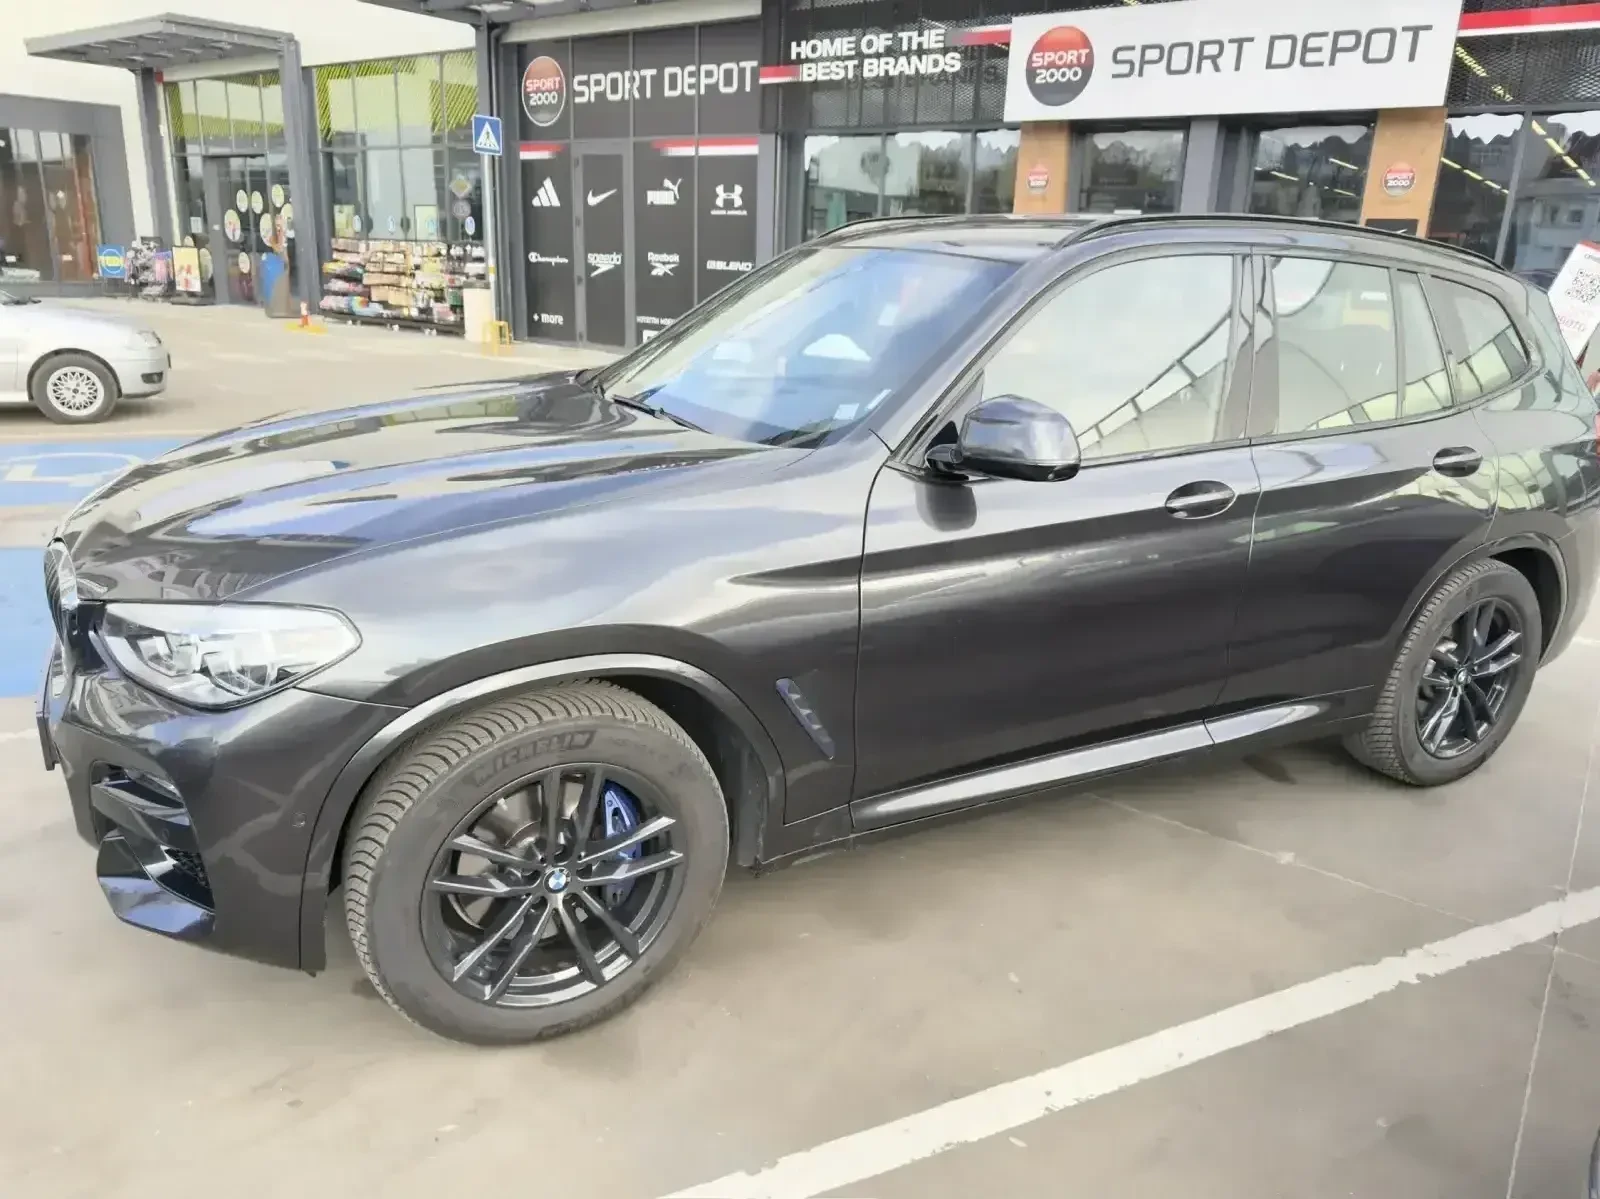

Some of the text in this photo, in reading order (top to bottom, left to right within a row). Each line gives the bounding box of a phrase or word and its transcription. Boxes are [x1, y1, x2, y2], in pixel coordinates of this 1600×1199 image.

[790, 29, 946, 60] HOME OF THE
[1112, 24, 1434, 79] SPORT DEPOT
[801, 52, 962, 82] BEST BRANDS
[1031, 48, 1090, 68] SPORT
[525, 76, 561, 92] SPORT
[573, 60, 758, 104] SPORT DEPOT
[1034, 67, 1082, 84] 2000
[529, 91, 558, 106] 2000
[587, 252, 622, 266] speedo
[540, 313, 564, 326] more
